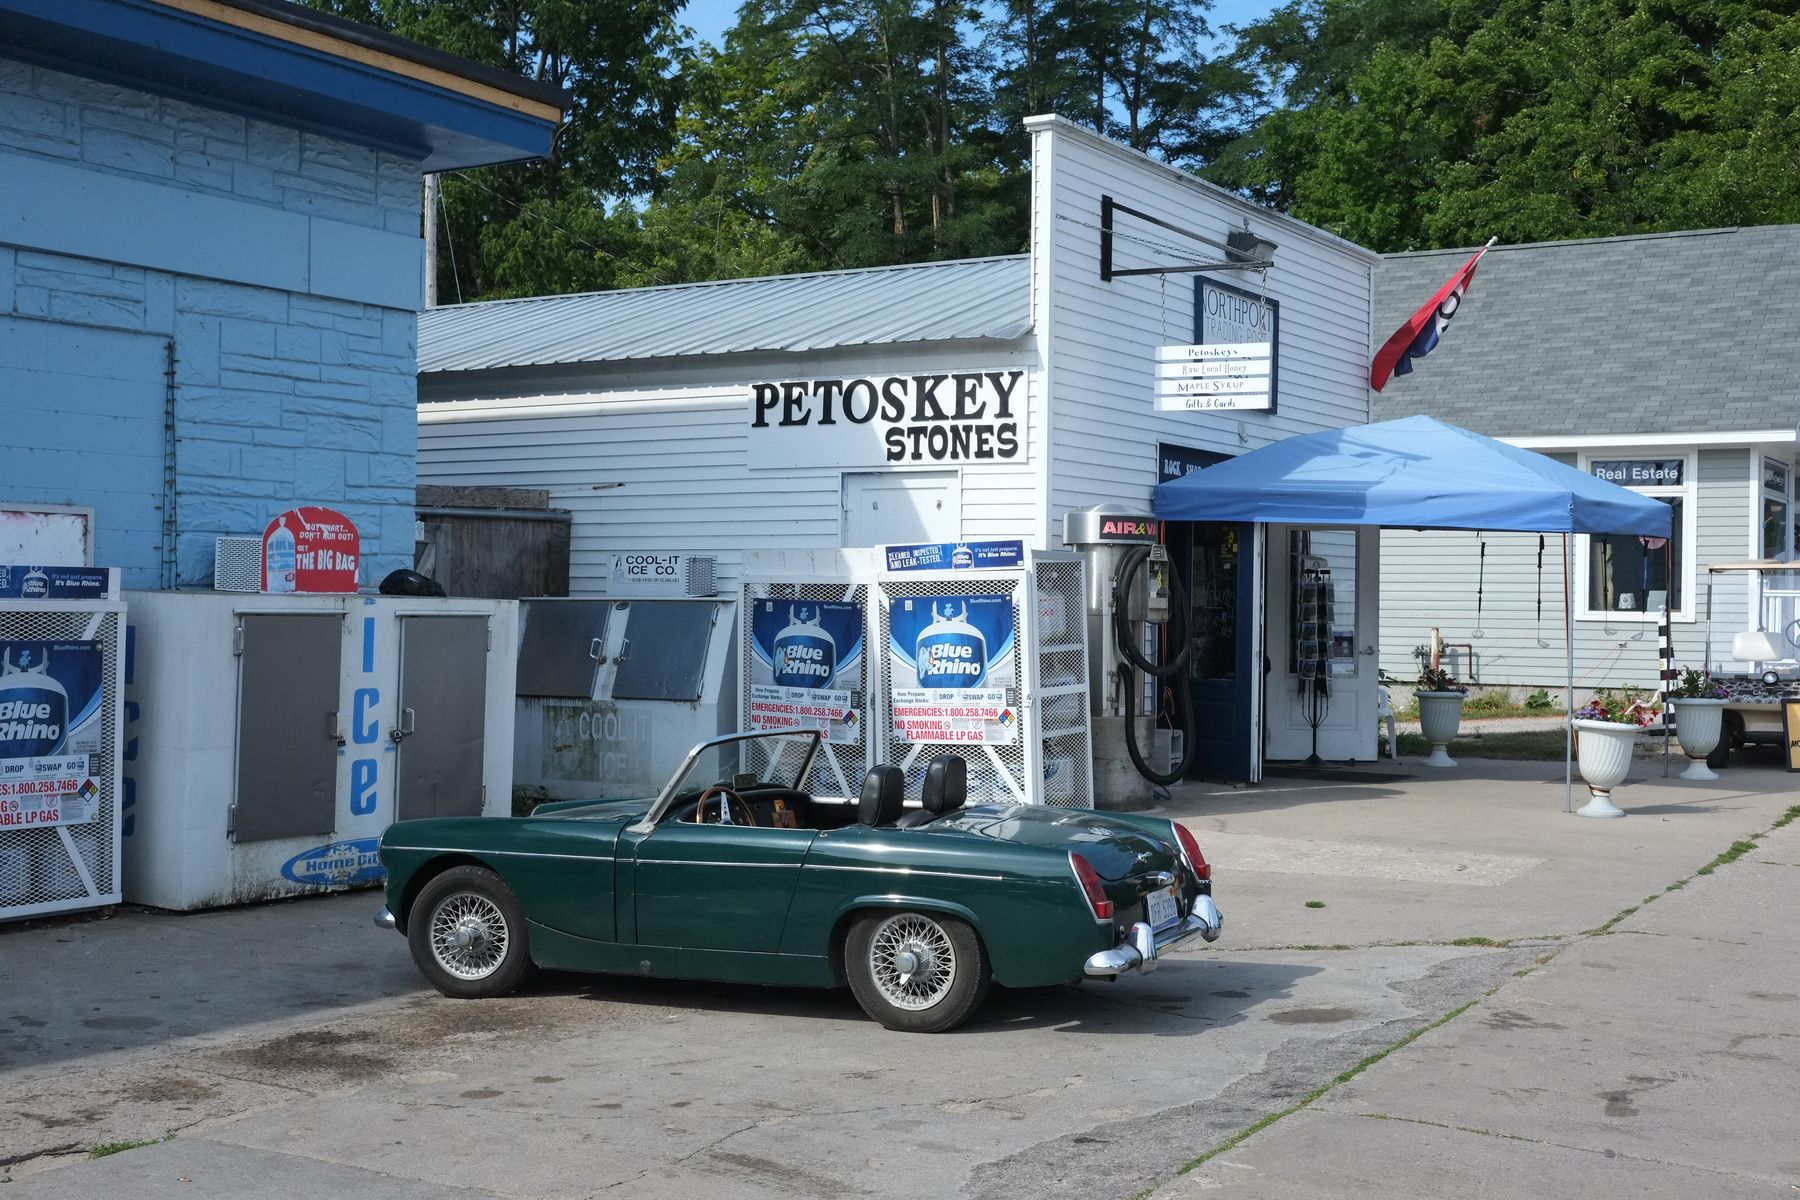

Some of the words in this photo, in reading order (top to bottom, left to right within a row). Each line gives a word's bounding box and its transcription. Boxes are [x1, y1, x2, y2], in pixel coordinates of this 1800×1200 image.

[1188, 348, 1238, 358] Petoskeys
[1182, 365, 1200, 375] Raw
[1202, 363, 1222, 375] Local
[1225, 363, 1247, 374] Honey
[751, 370, 1024, 428] PETOSKEY
[1186, 398, 1203, 409] Gifts
[1206, 399, 1212, 408] &
[1214, 398, 1236, 408] Cards
[885, 422, 1019, 461] STONES
[1164, 459, 1181, 476] ROCK
[1596, 468, 1626, 480] Real
[1632, 467, 1678, 479] Estate
[300, 531, 320, 540] DON'T
[296, 552, 315, 570] THE
[317, 549, 333, 570] BIG
[335, 552, 355, 570] BAG
[626, 555, 680, 565] COOL-IT
[890, 560, 902, 569] AND
[628, 565, 648, 575] ICE
[655, 565, 677, 575] CO.
[787, 645, 823, 660] Blue
[931, 643, 973, 658] Blue
[782, 660, 830, 677] Rhino
[928, 659, 980, 676] Rhino
[0, 700, 51, 719] Blue
[579, 712, 627, 741] COOL
[752, 714, 761, 723] NO
[762, 715, 793, 727] SMOKING
[894, 720, 905, 729] NO
[907, 720, 943, 730] SMOKING
[0, 720, 60, 740] Rhino
[906, 730, 954, 740] FLAMMABLE
[956, 731, 966, 740] LP
[967, 730, 984, 740] GAS
[5, 765, 24, 773] DROP
[42, 763, 62, 772] SWAP
[599, 752, 627, 779] ICE
[25, 811, 38, 823] LP
[40, 810, 59, 822] GAS
[306, 857, 355, 872] Home
[358, 852, 378, 866] Cit
